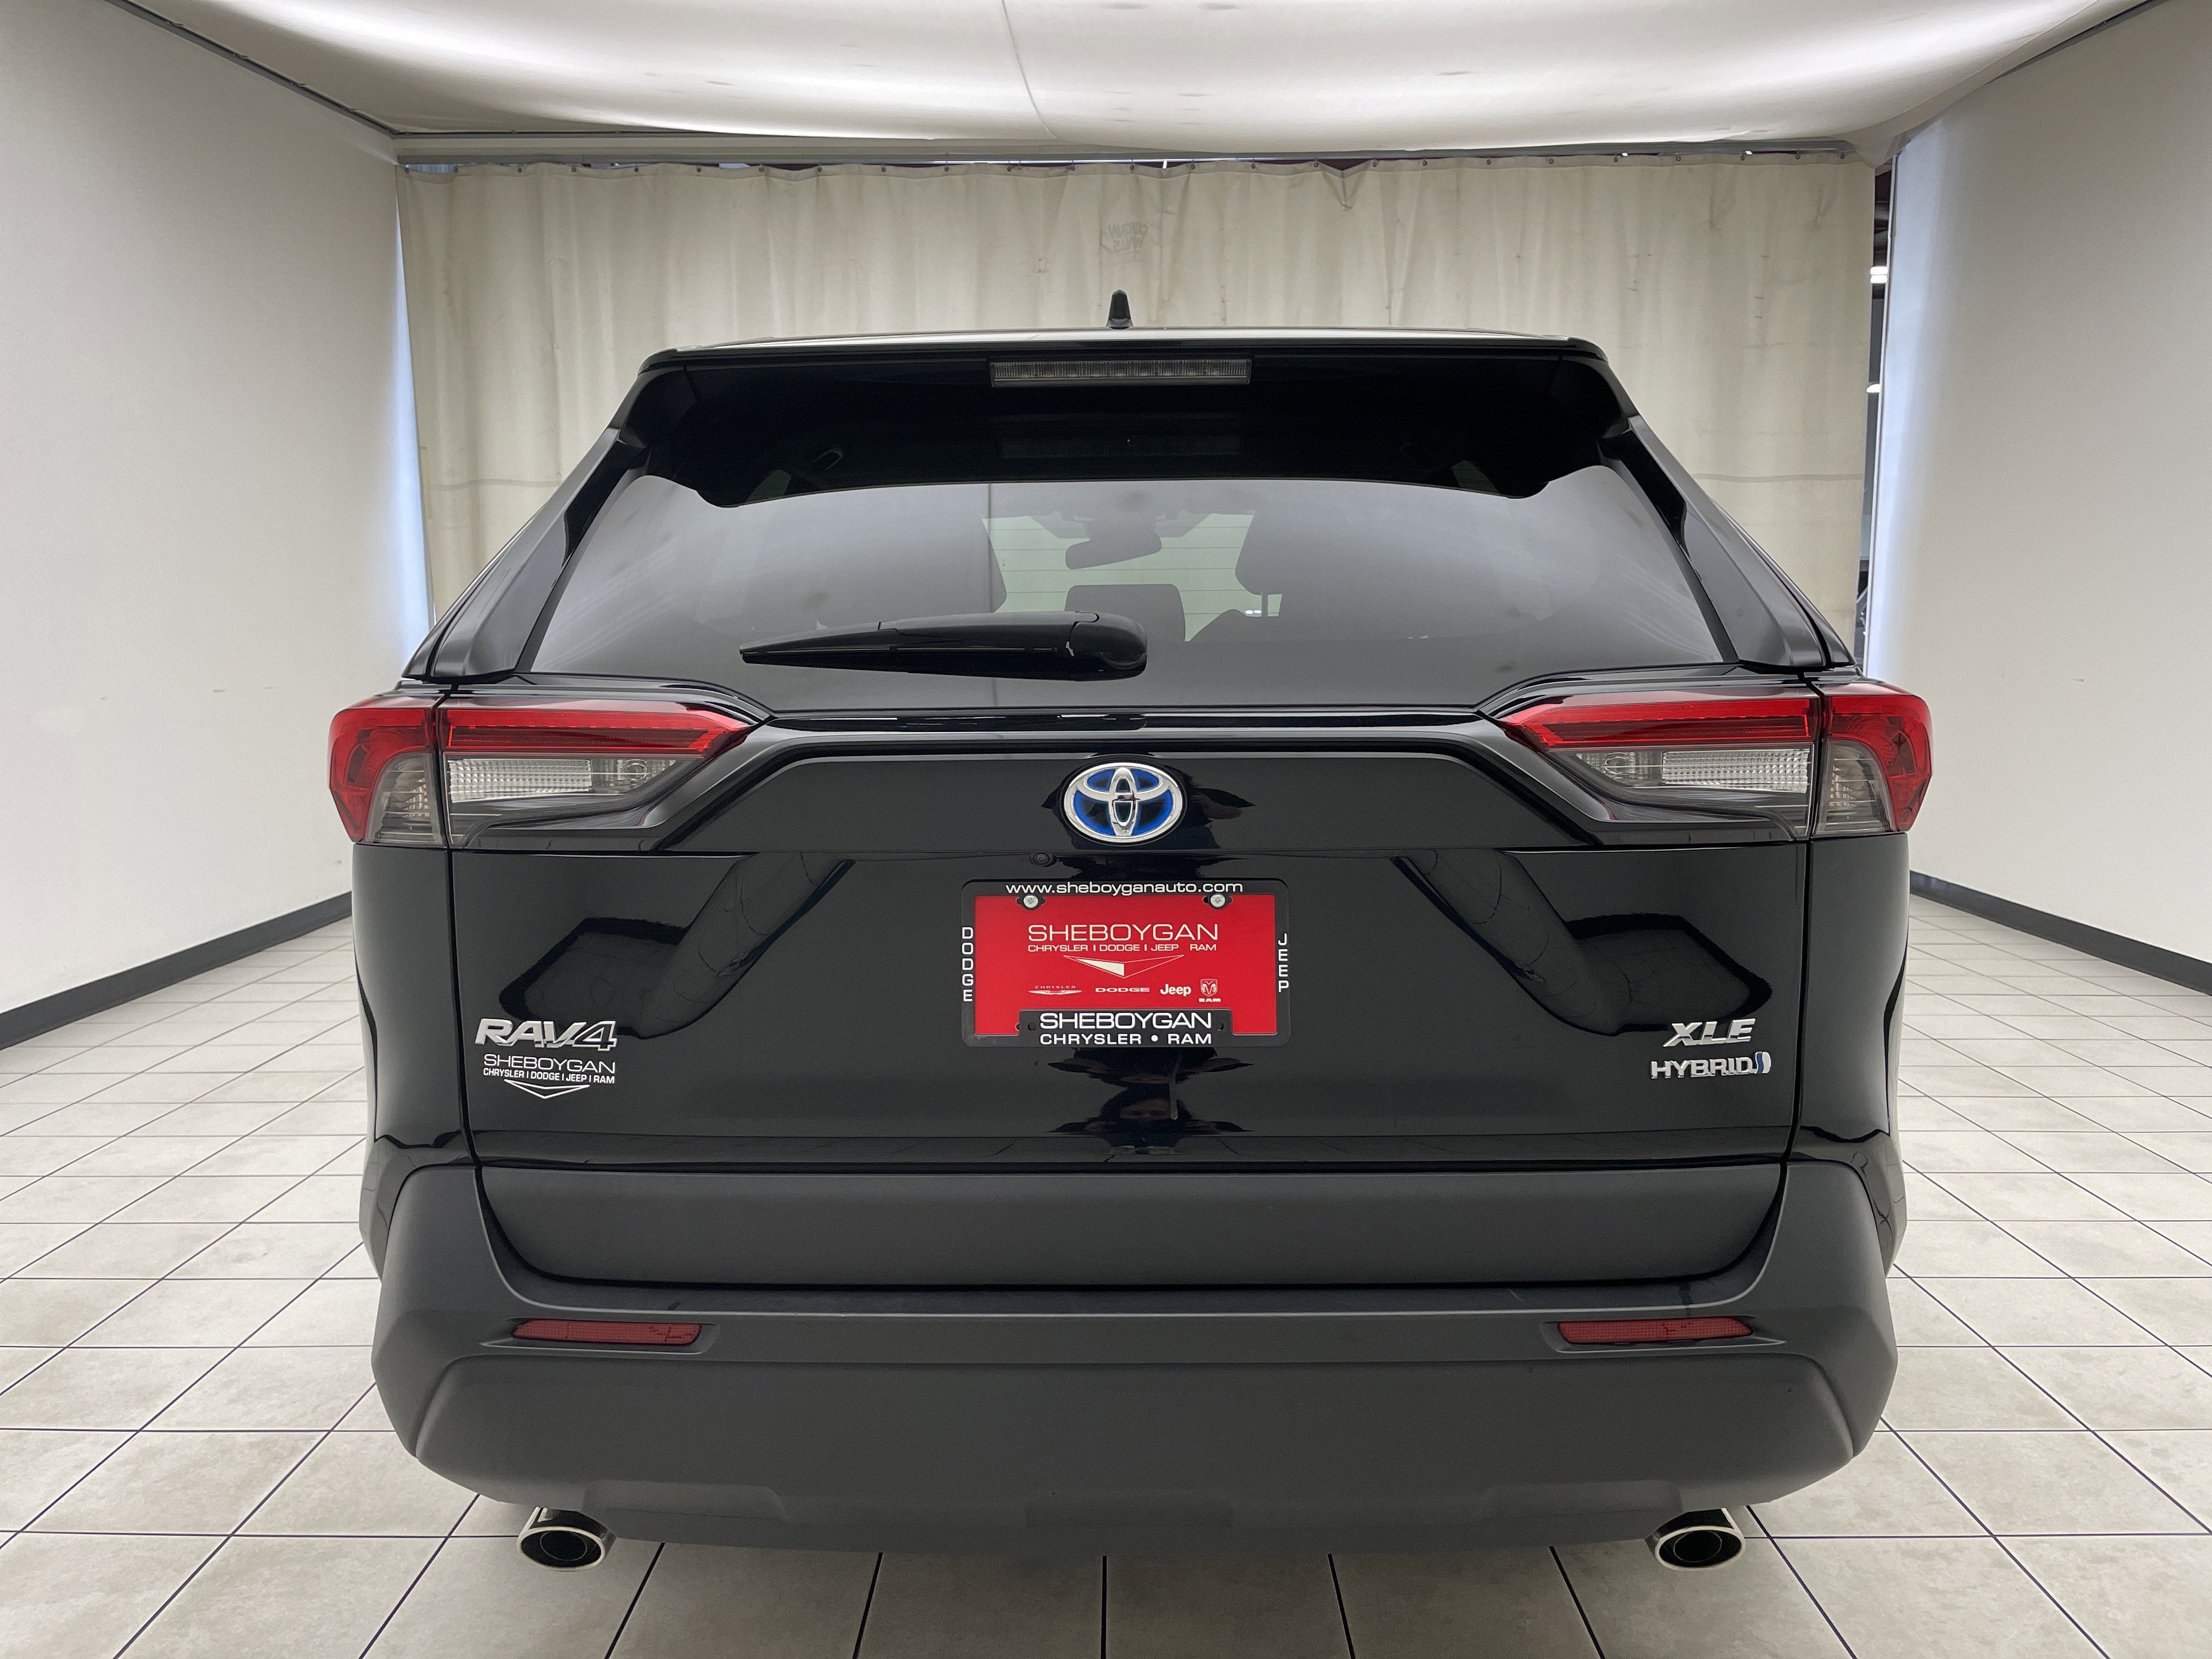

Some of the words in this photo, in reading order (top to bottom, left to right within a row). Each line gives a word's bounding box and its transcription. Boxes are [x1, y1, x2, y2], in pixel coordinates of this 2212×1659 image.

[1005, 881, 1244, 895] www.sheboyganauto.com
[1028, 924, 1218, 941] SHEBOYGAN
[1028, 944, 1088, 952] CHRYSLER
[1099, 944, 1140, 952] DODGE
[1150, 944, 1179, 952] JEEP
[961, 927, 974, 1002] DODGE
[1278, 933, 1290, 993] JEEP
[1159, 983, 1192, 997] Jeep
[1039, 1012, 1212, 1029] SHEBOYGAN
[475, 1018, 618, 1052] RAV4
[1039, 1033, 1142, 1045] CHRYSLER
[1167, 1033, 1212, 1045] RAM
[1662, 1018, 1756, 1047] XLE
[483, 1053, 616, 1074] SHEBOYGAN
[1650, 1057, 1755, 1079] HYBRID
[483, 1068, 524, 1079] CHRYSLER
[531, 1070, 560, 1081] DODGE
[566, 1073, 587, 1082] JEEP
[593, 1075, 616, 1085] RAM
